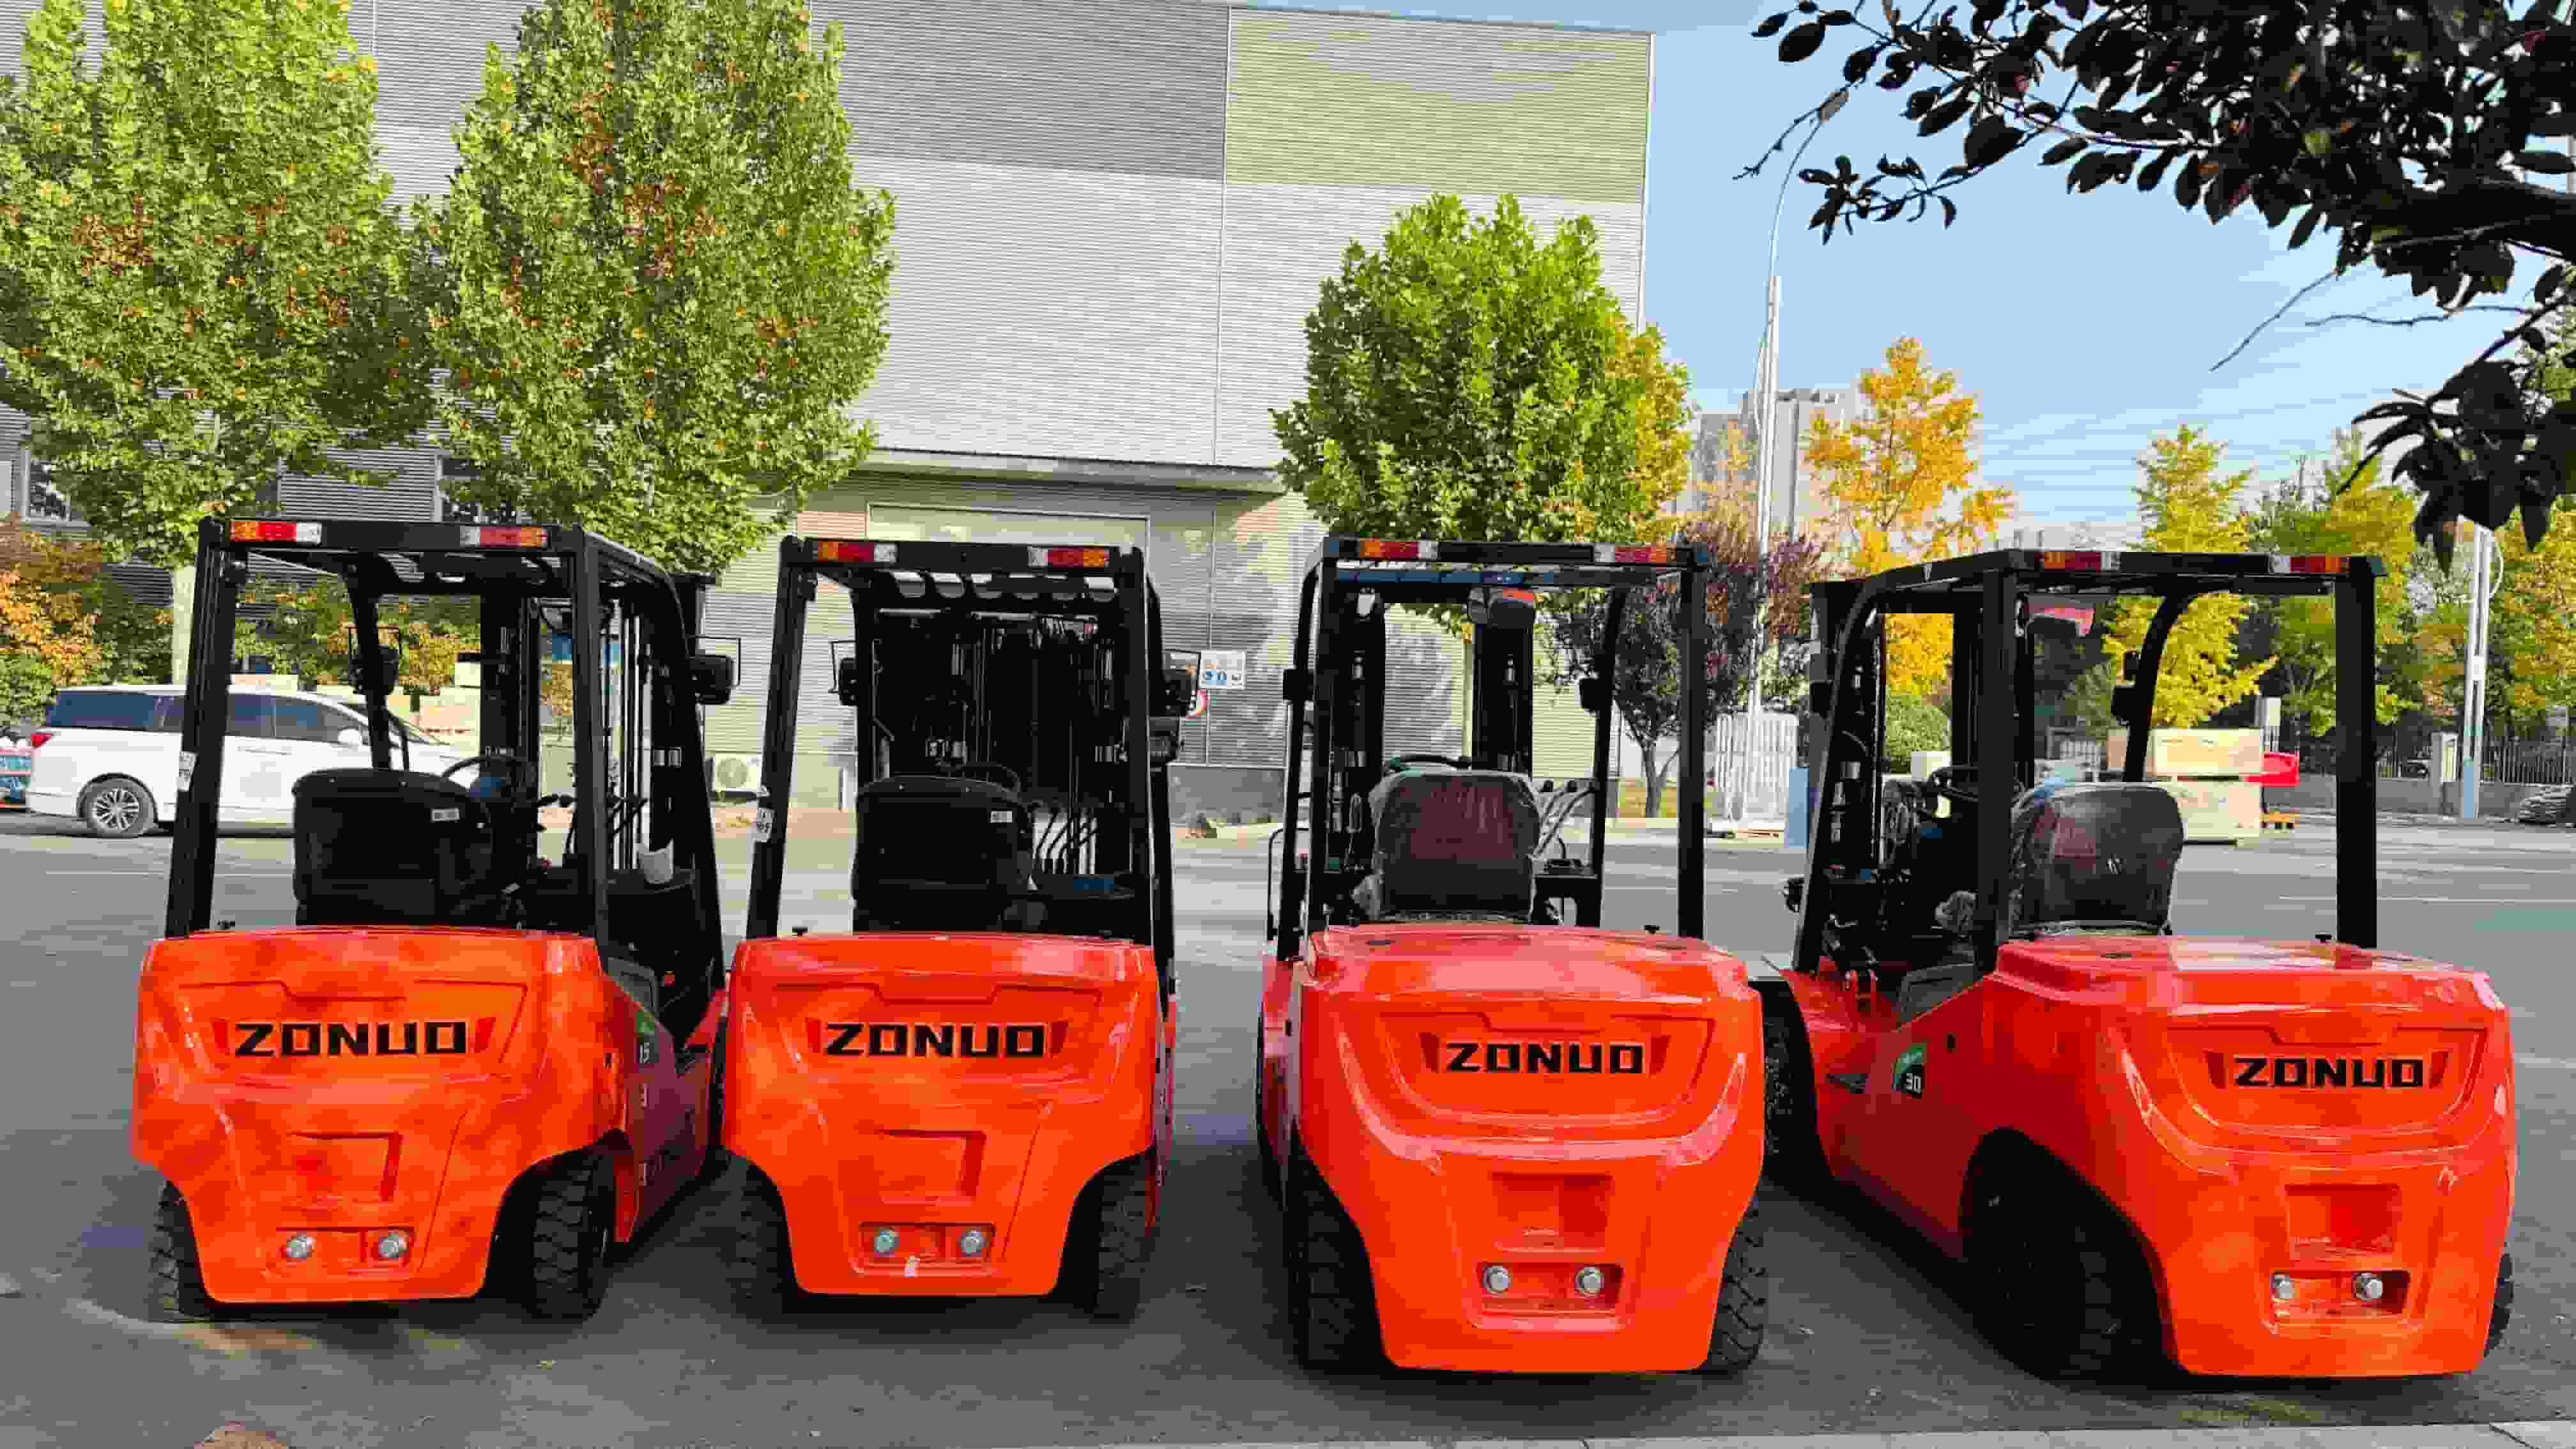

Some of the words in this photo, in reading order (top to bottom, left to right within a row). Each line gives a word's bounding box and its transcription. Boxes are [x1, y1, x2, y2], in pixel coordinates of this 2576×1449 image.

[234, 1022, 466, 1056] ZONUO
[826, 1023, 1045, 1057] ZONUO
[1448, 1042, 1644, 1074] ZONUO
[2235, 1057, 2424, 1087] ZONUO
[1906, 1073, 1922, 1094] 30
